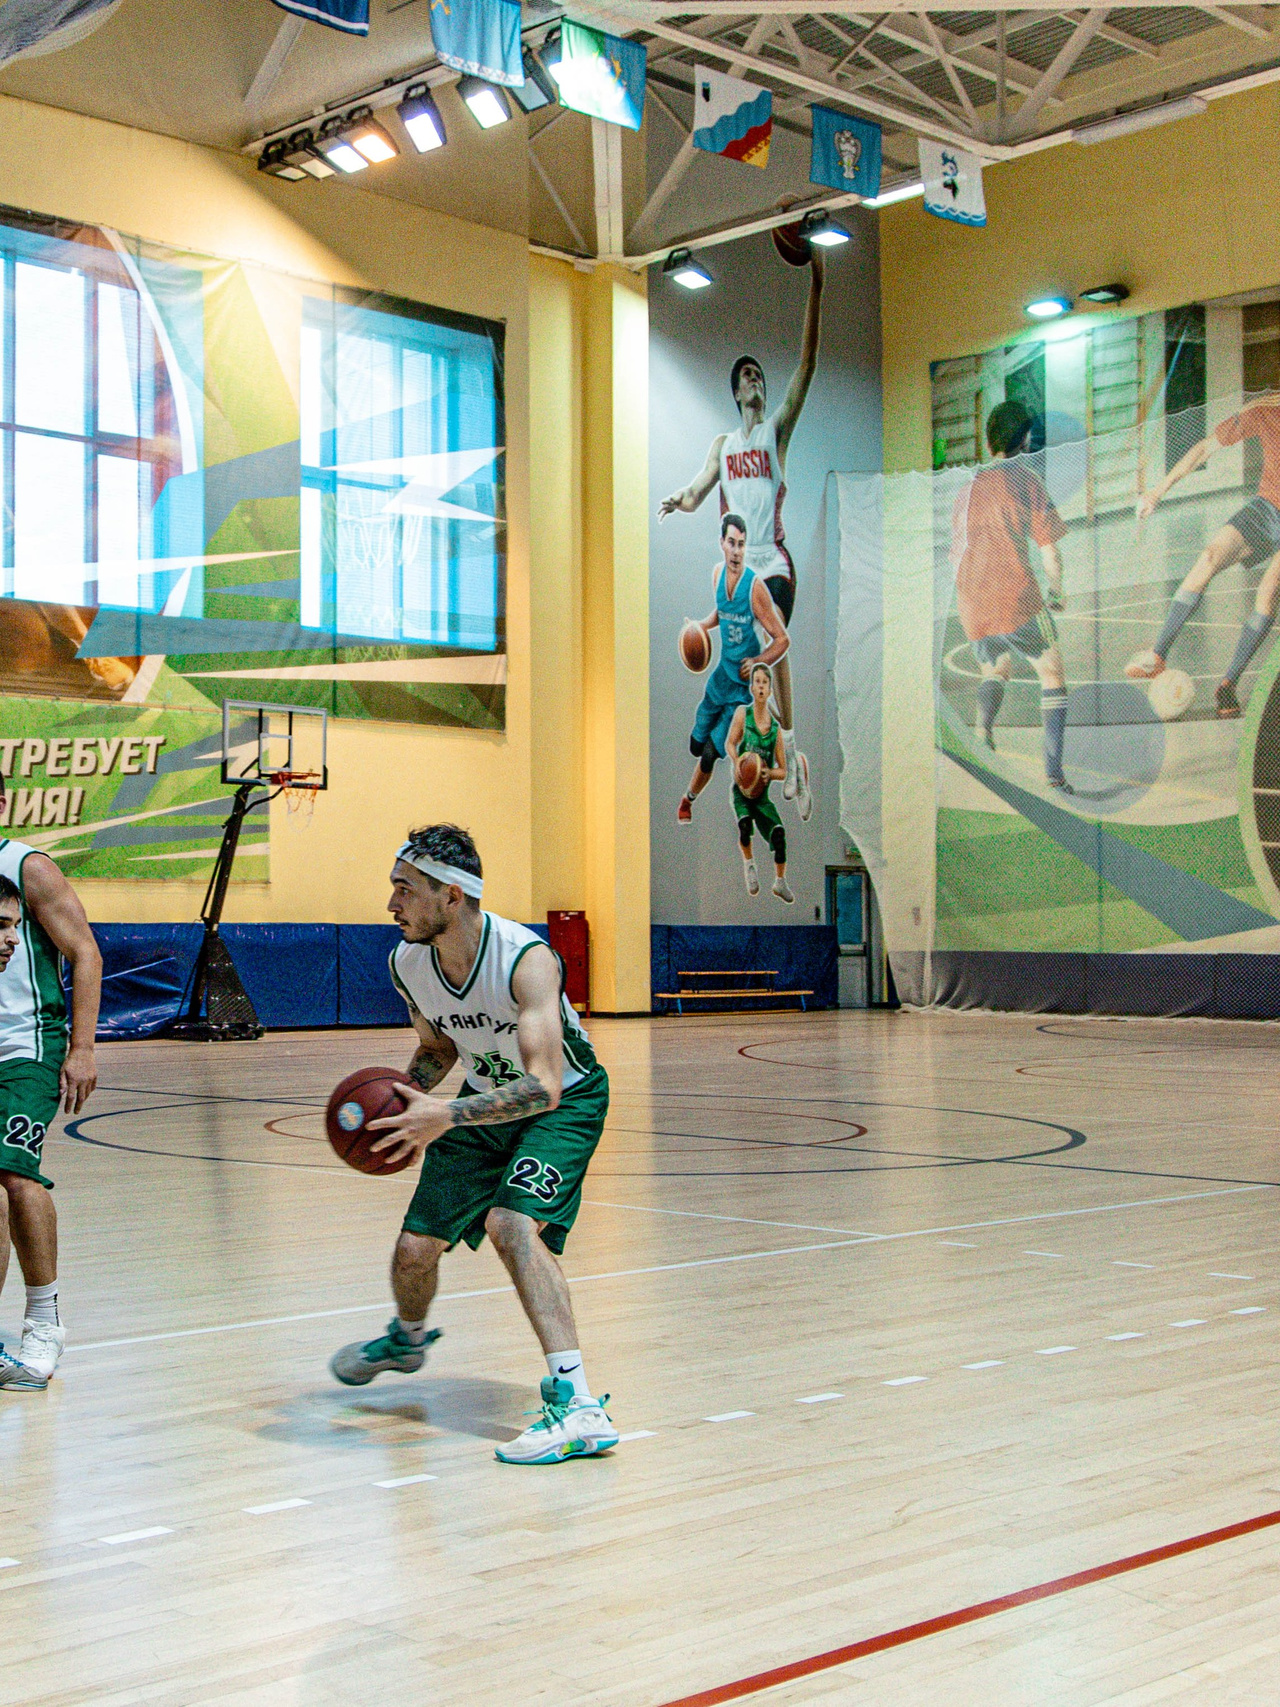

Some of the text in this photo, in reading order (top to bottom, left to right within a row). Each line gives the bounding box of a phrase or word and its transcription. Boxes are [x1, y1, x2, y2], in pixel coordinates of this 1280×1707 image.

[726, 449, 773, 480] RUSSIA
[3, 1114, 46, 1159] 22
[507, 1156, 563, 1203] 23
